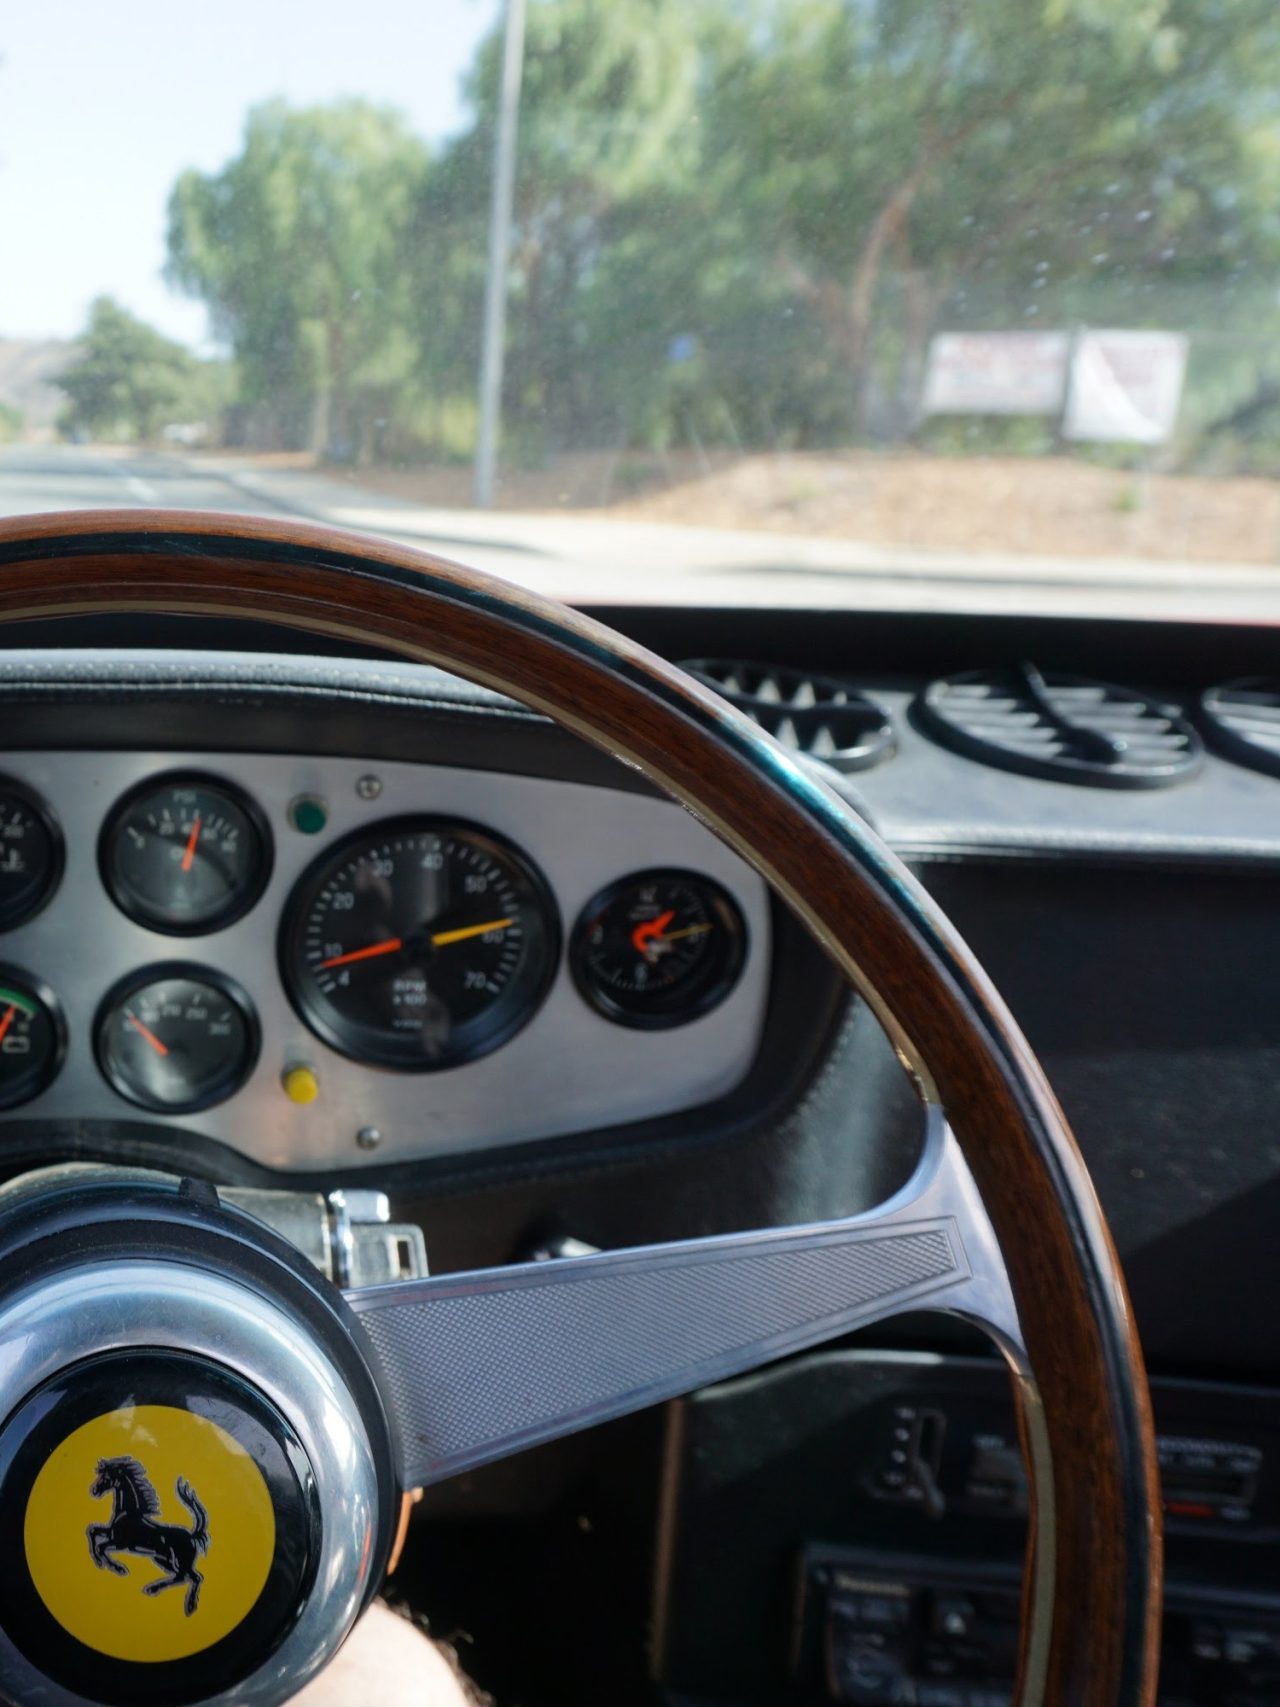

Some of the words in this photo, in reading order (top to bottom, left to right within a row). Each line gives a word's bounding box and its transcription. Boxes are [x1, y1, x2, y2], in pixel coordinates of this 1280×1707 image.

[421, 852, 443, 870] 40
[464, 875, 487, 893] 50
[333, 892, 354, 910] 20
[338, 970, 351, 986] 4
[393, 979, 427, 993] RPM
[464, 972, 487, 989] 70
